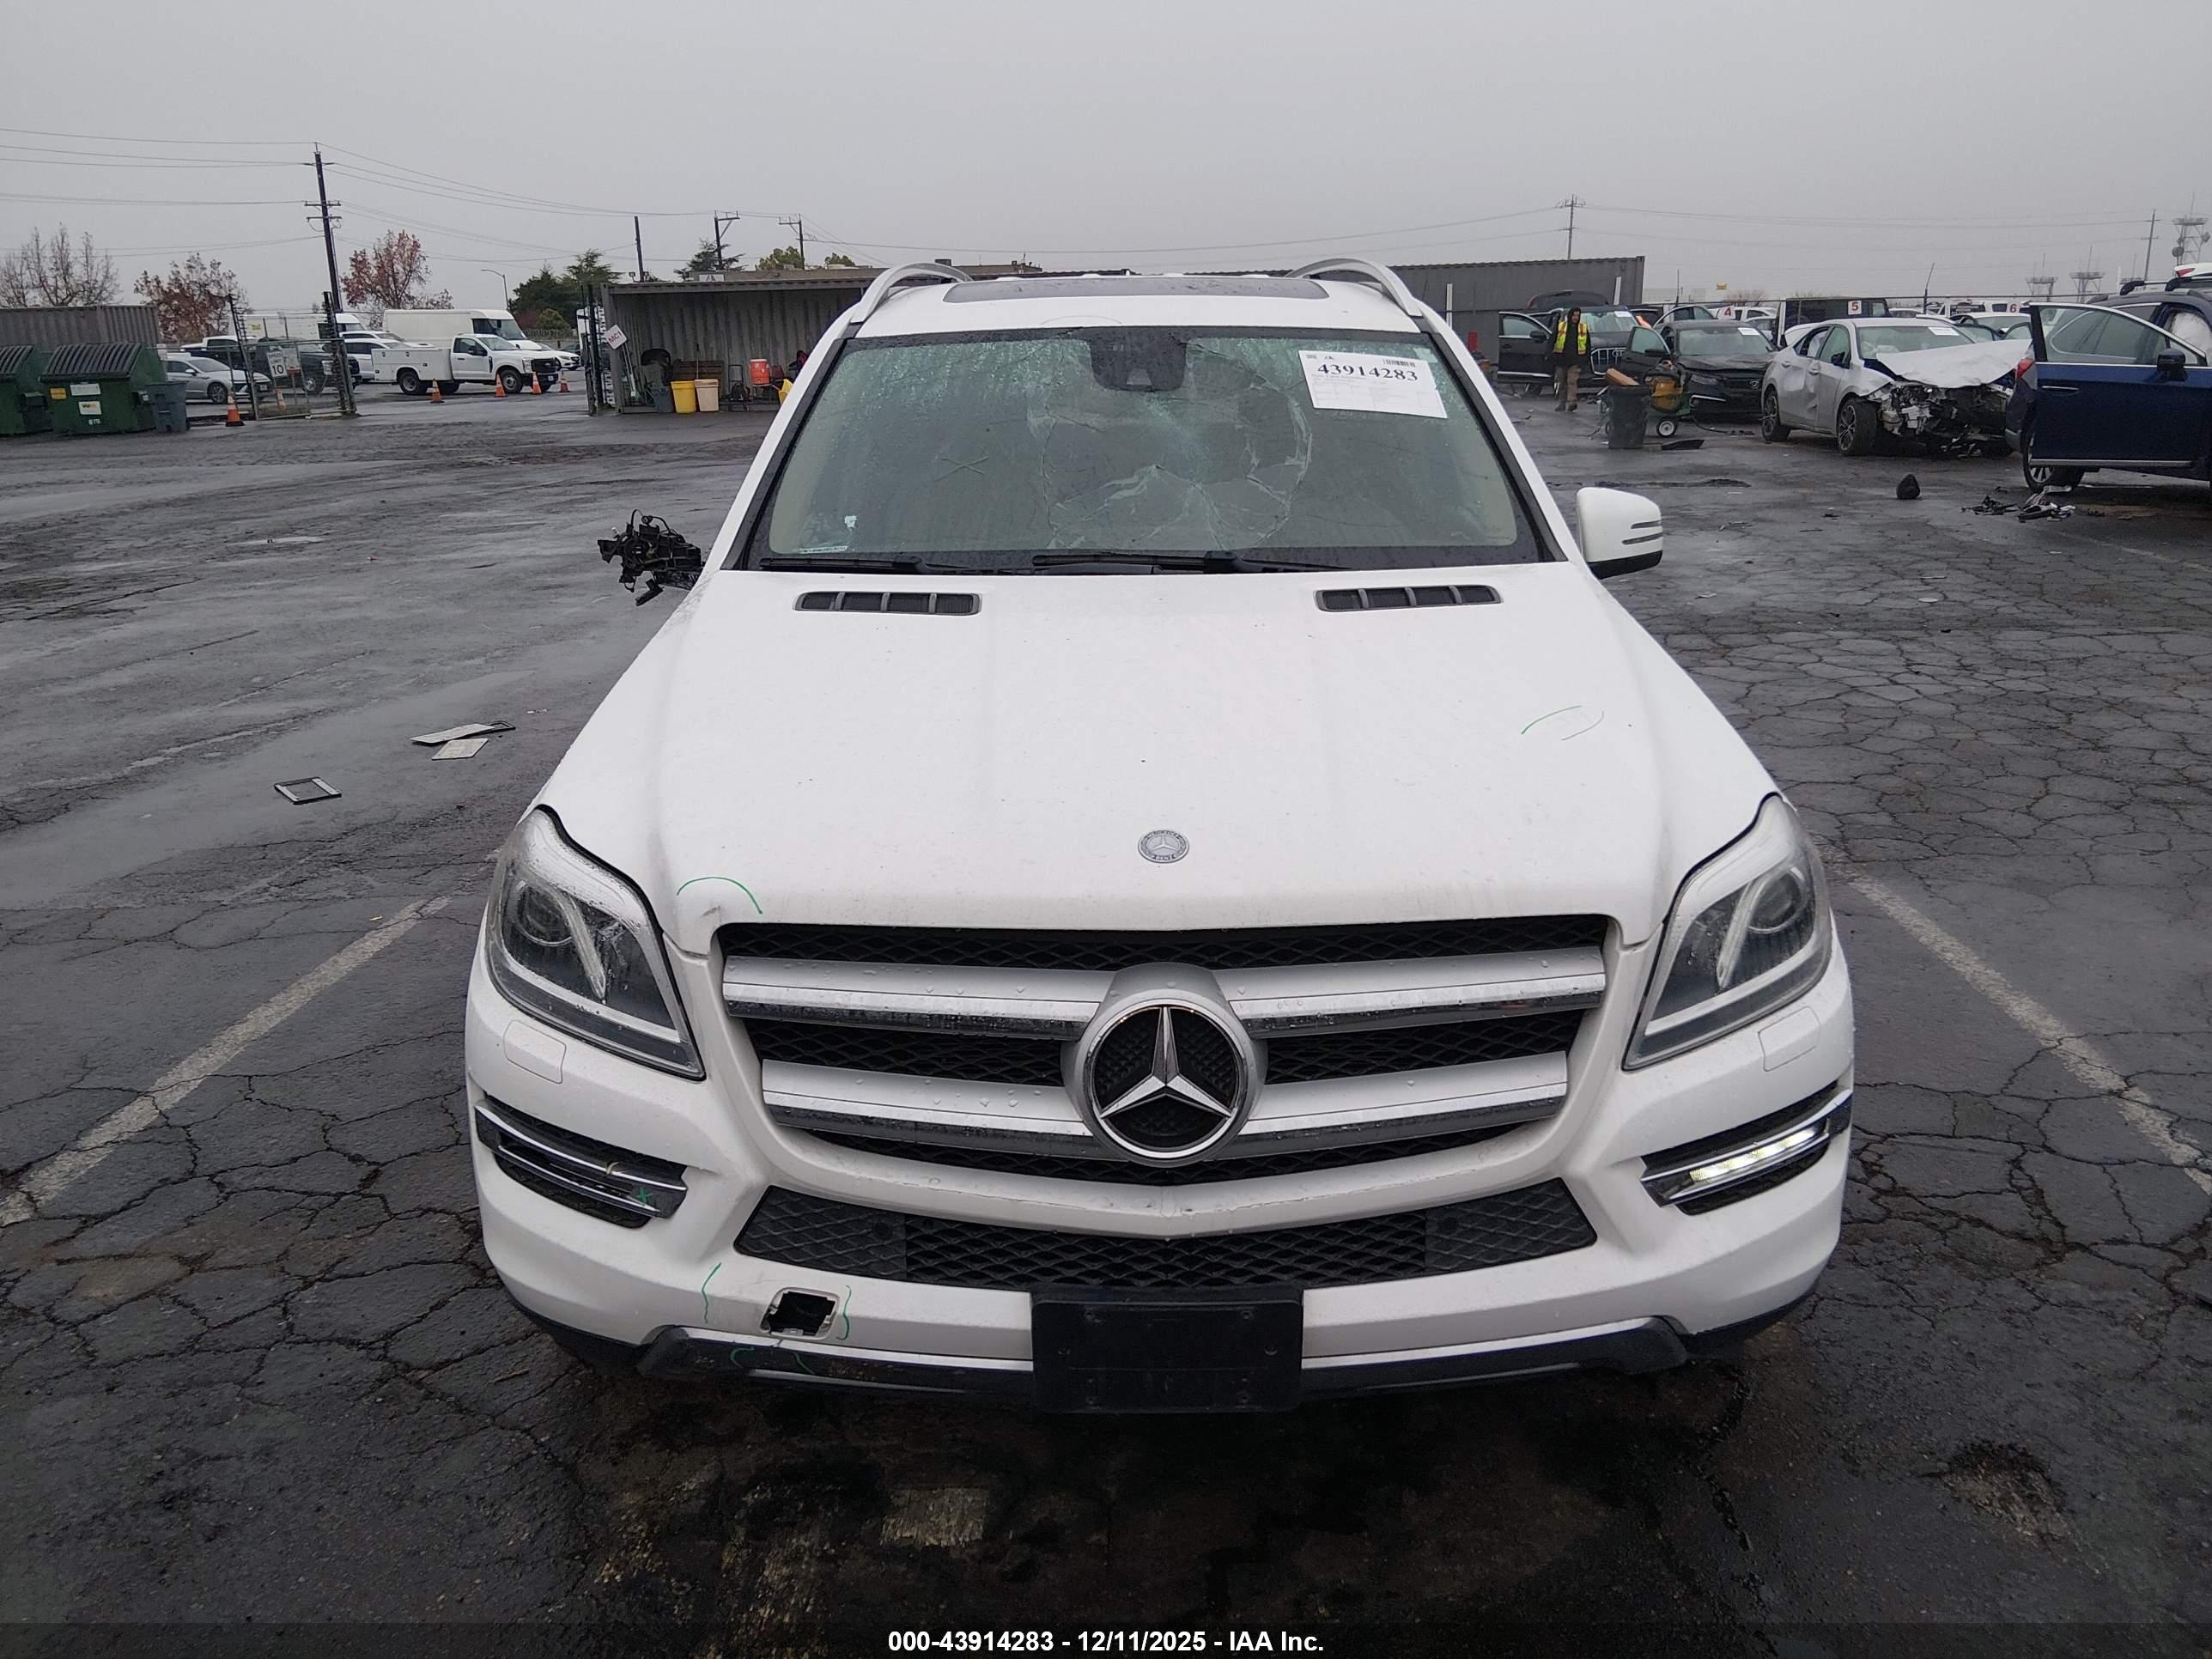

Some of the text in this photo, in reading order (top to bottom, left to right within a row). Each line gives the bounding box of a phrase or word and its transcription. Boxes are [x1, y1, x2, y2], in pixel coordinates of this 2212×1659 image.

[1852, 301, 1859, 312] 5
[2009, 303, 2018, 313] 6
[1724, 307, 1732, 317] 4
[271, 364, 284, 374] 10
[1317, 363, 1419, 382] 43914283
